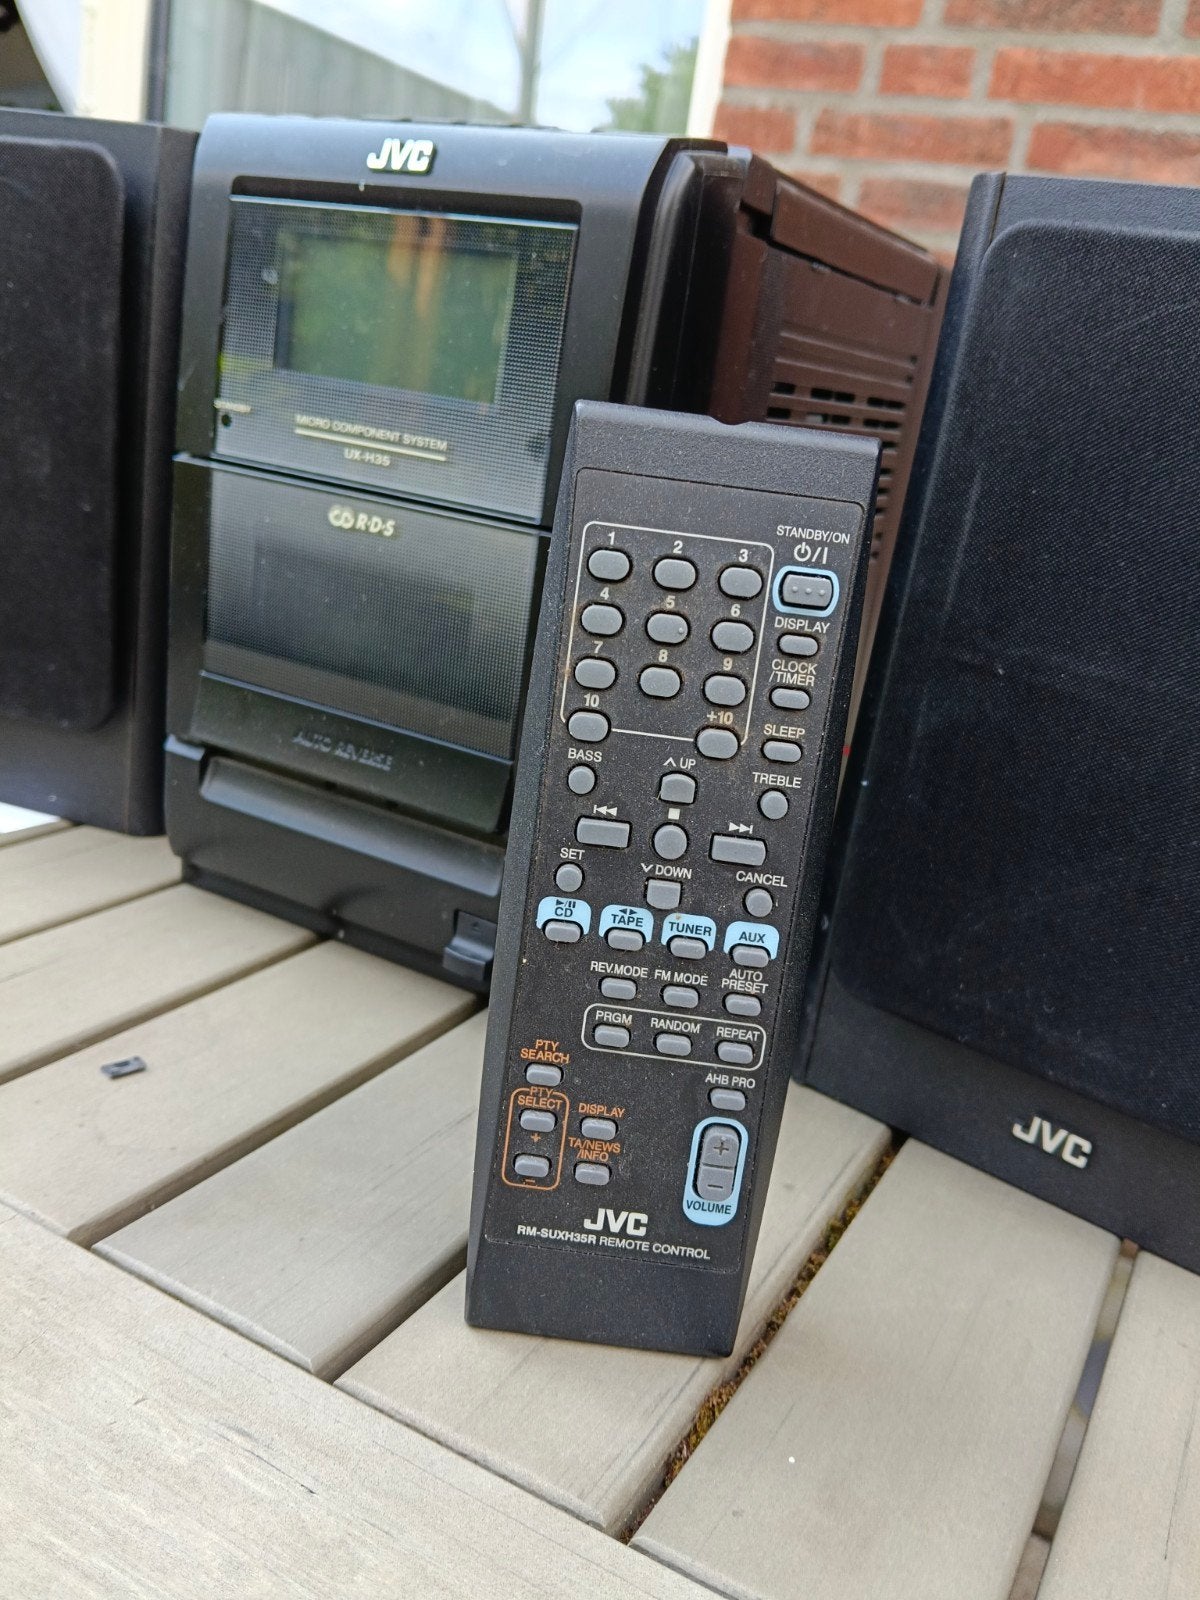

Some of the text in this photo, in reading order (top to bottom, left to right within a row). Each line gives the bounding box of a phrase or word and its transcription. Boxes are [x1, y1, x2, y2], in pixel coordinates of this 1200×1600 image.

[366, 137, 434, 172] JVC
[295, 415, 448, 451] MICRO COMPONENT SYSTEM
[607, 531, 615, 545] 1
[776, 525, 851, 544] STANDBY/ON
[673, 540, 683, 554] 2
[738, 549, 749, 562] 3
[599, 587, 610, 600] 4
[665, 596, 676, 609] 5
[730, 604, 741, 617] 6
[774, 616, 831, 634] DISPLAY
[594, 641, 604, 654] 7
[658, 650, 668, 663] 8
[723, 658, 733, 671] 9
[771, 659, 818, 675] CLOCK
[768, 671, 815, 687] /TIMER
[584, 694, 599, 707] 10
[707, 711, 734, 725] +10
[763, 724, 806, 738] SLEEP
[567, 748, 602, 763] BASS
[679, 758, 696, 771] UP
[752, 772, 802, 788] TREBLE
[560, 848, 585, 861] SET
[655, 865, 693, 880] DOWN
[736, 871, 788, 888] CANCEL
[554, 907, 573, 918] CD
[611, 914, 644, 928] TAPE
[668, 921, 712, 937] TUNER
[738, 931, 766, 944] AUX
[590, 961, 649, 978] REV.MODE
[729, 968, 763, 982] AUTO
[654, 970, 708, 986] FM MODE
[721, 978, 769, 994] PRESET
[595, 1011, 632, 1025] PRGM
[650, 1018, 700, 1034] RANDOM
[716, 1027, 761, 1042] REPEAT
[535, 1039, 559, 1052] PTY
[520, 1048, 570, 1064] SEARCH
[705, 1072, 756, 1089] AHB PRO
[530, 1086, 553, 1099] PTY
[517, 1095, 563, 1110] SELECT
[578, 1103, 626, 1118] DISPLAY
[568, 1137, 621, 1154] TA/NEWS
[1012, 1116, 1093, 1169] JVC
[576, 1149, 609, 1162] /INFO
[686, 1200, 733, 1215] VOLUME
[583, 1208, 649, 1237] JVC
[516, 1224, 711, 1260] RM-SUXH35R REMOTE CONTROL
